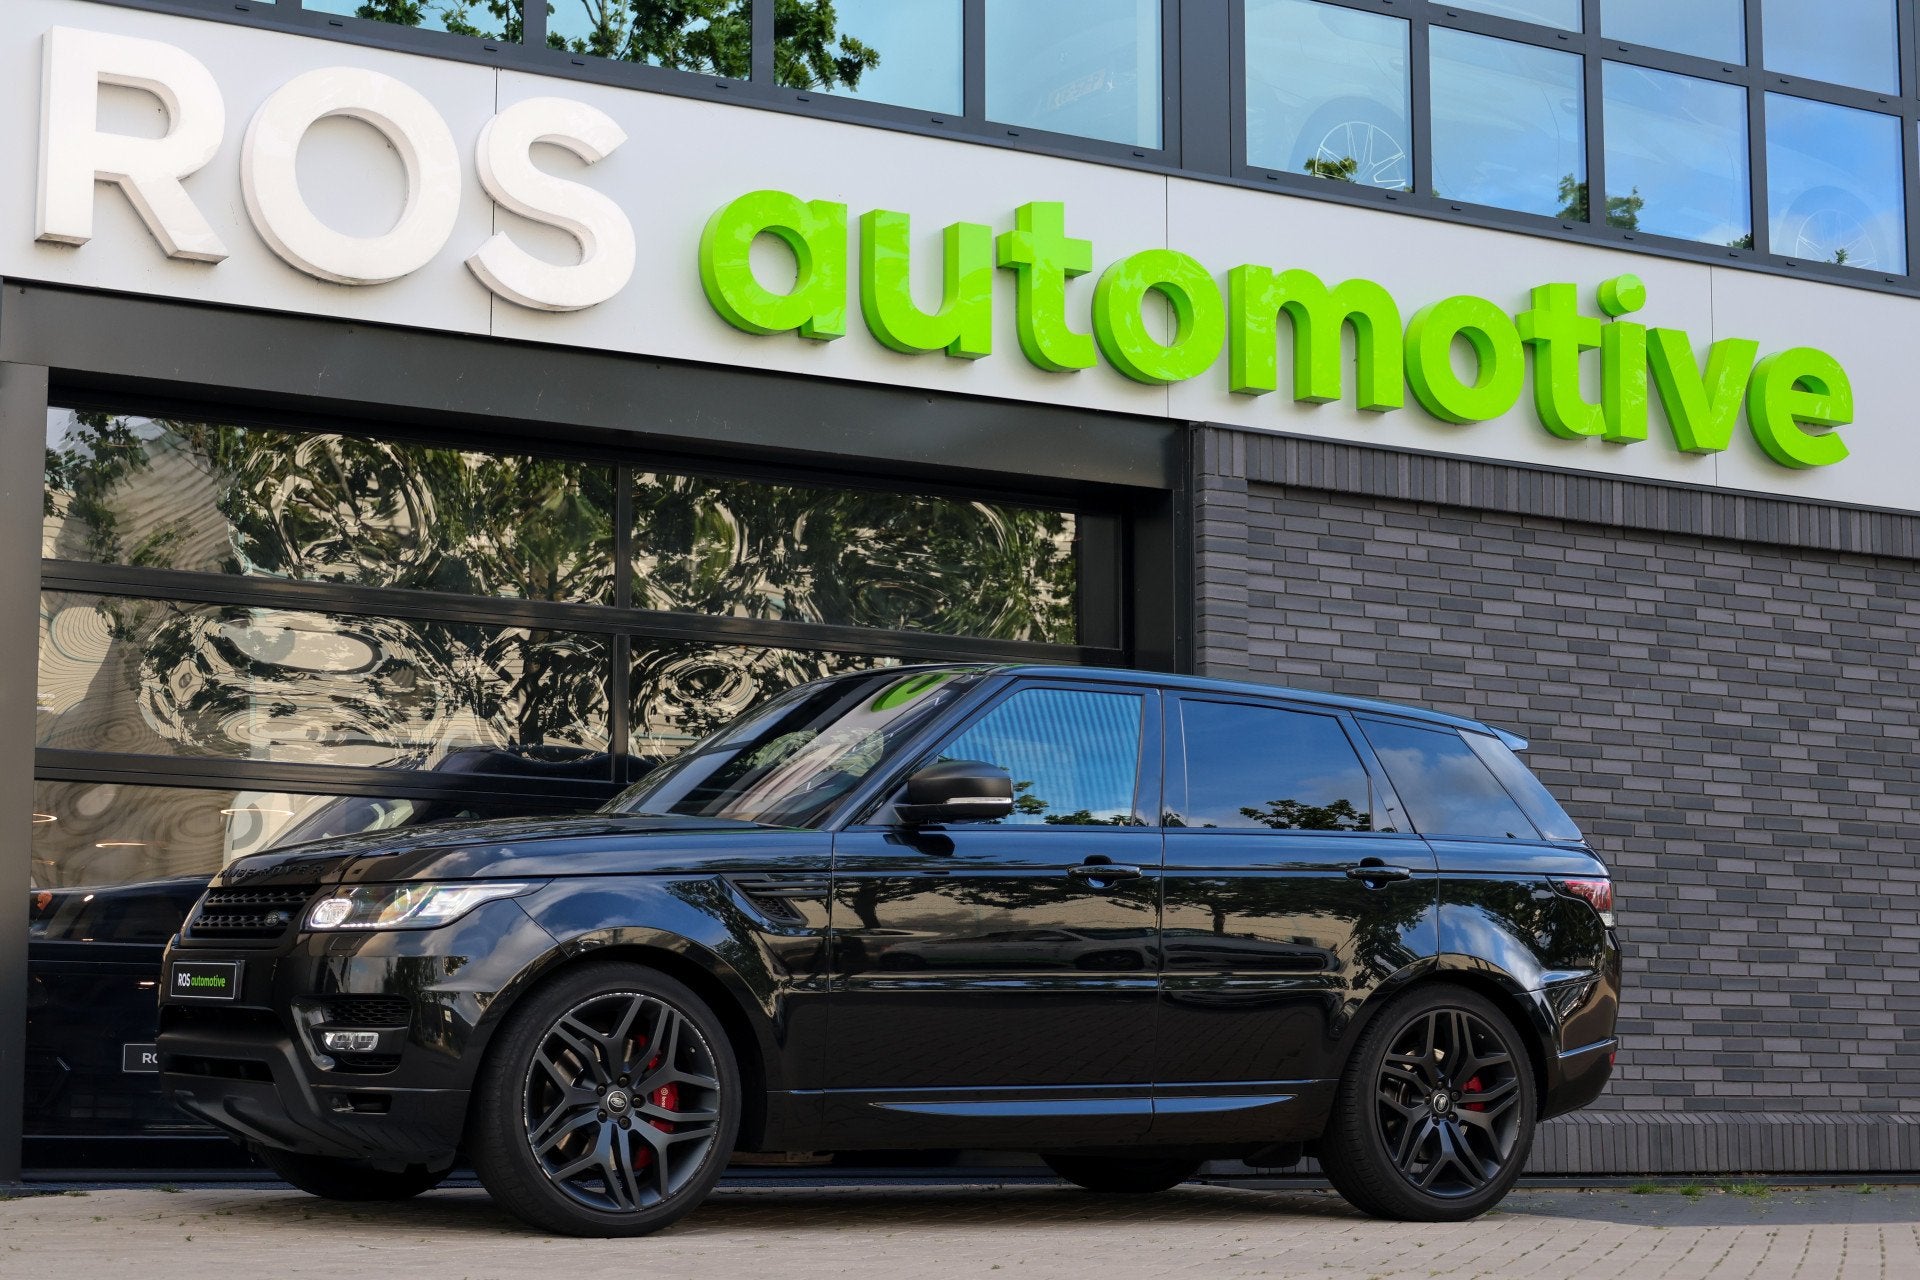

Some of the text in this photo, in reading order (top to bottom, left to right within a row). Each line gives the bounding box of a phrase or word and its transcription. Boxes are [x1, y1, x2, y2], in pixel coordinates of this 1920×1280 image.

[35, 24, 1854, 471] ROS automotive
[178, 973, 226, 987] ROS automotive
